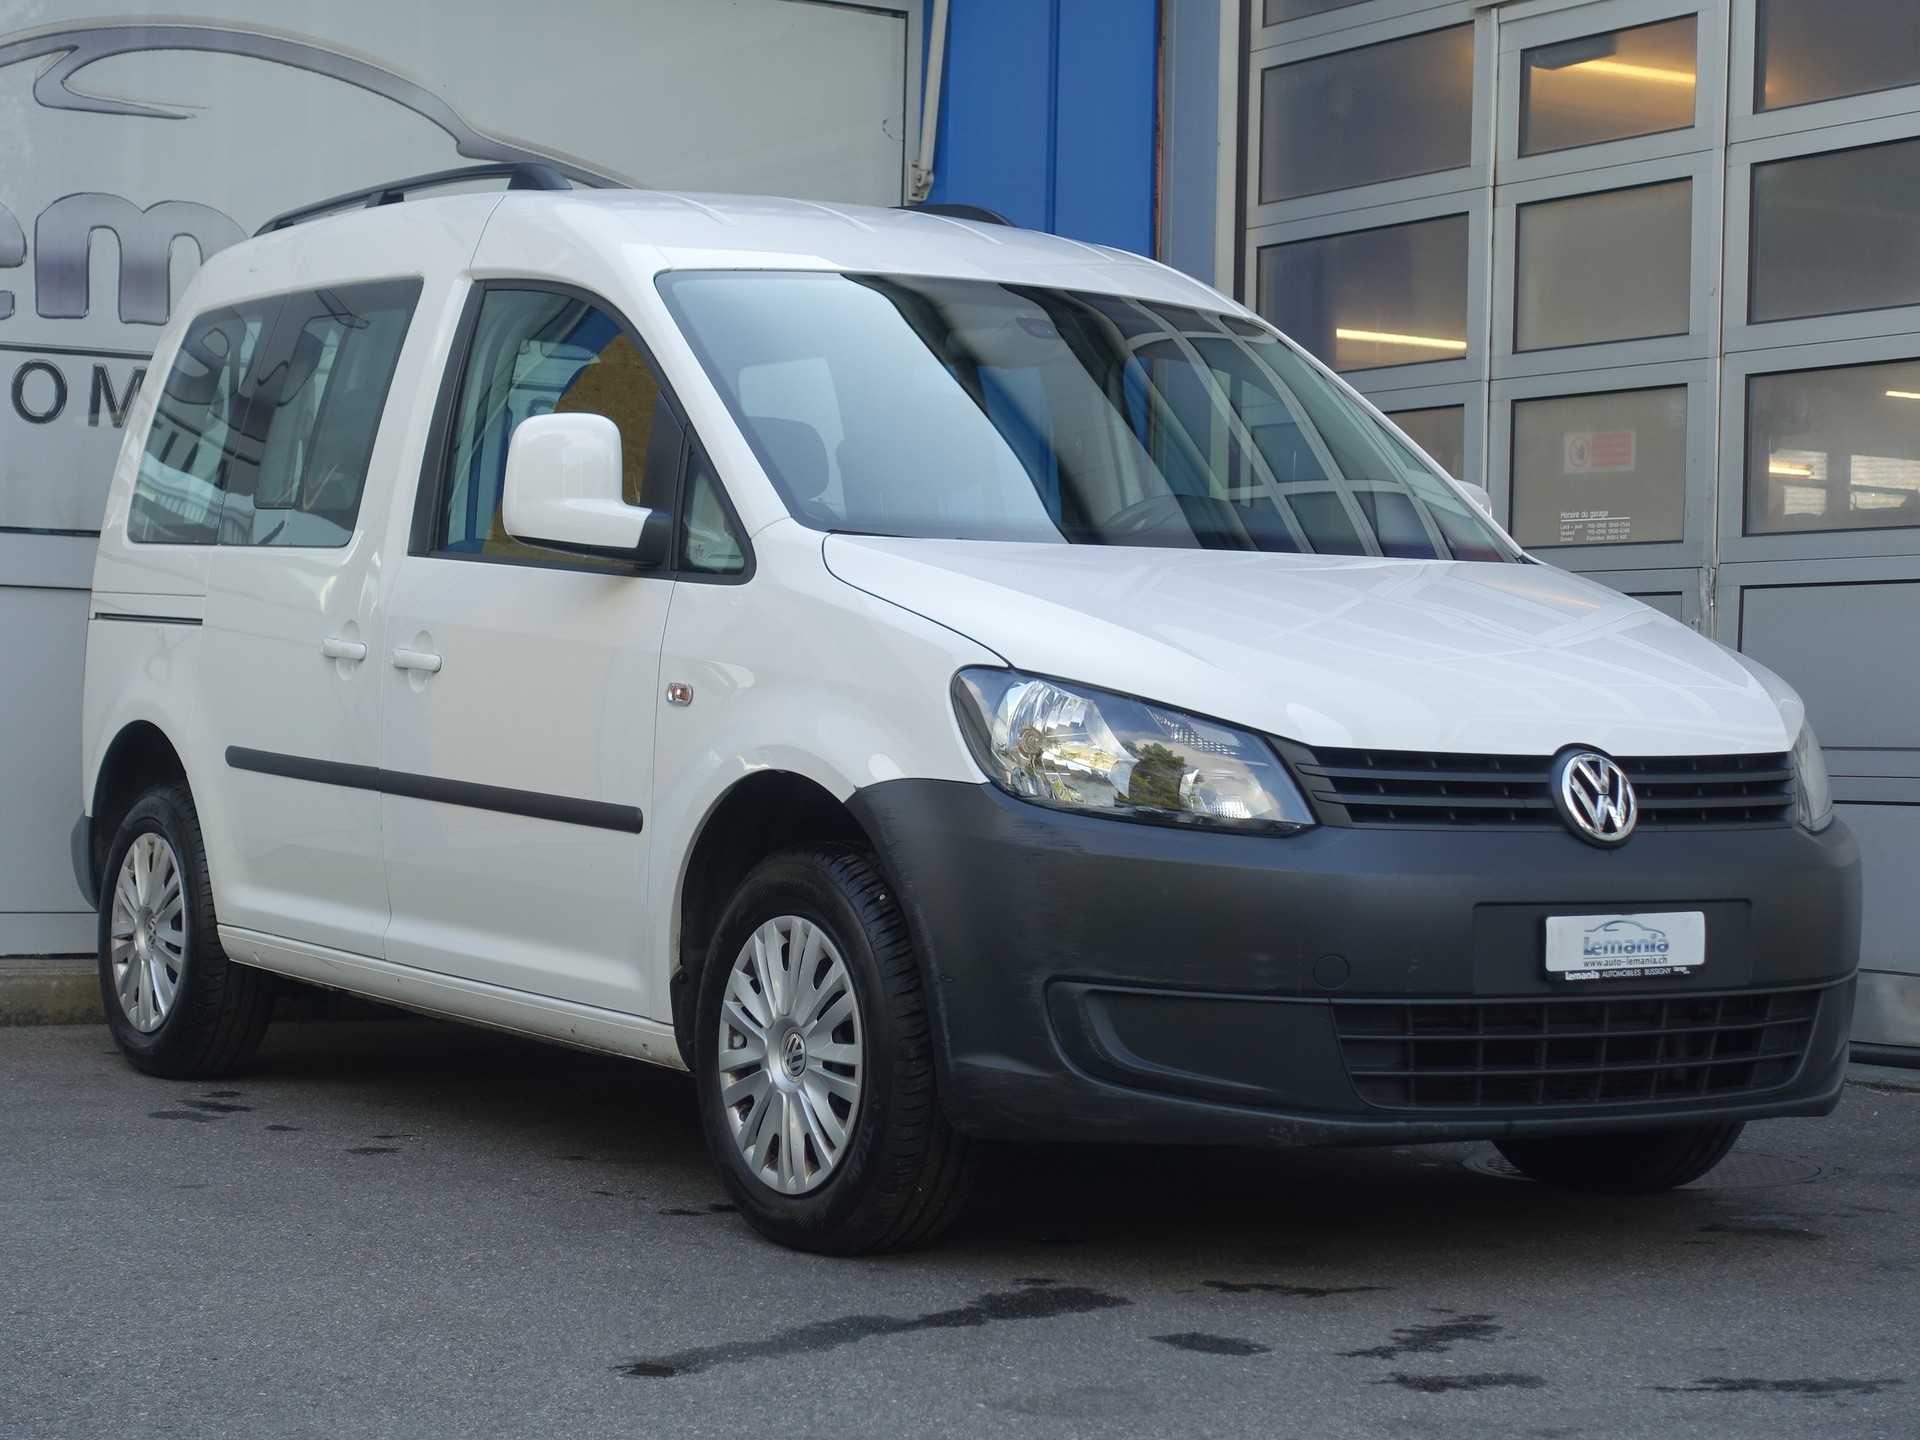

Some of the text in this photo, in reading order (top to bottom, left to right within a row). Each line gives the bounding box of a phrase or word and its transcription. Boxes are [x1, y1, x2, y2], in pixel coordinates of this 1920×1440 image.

[1589, 510, 1609, 519] garage
[1583, 933, 1669, 956] Lemania
[1583, 956, 1668, 968] www.auto-lemania.ch
[1601, 969, 1642, 978] AUTOMOBILES
